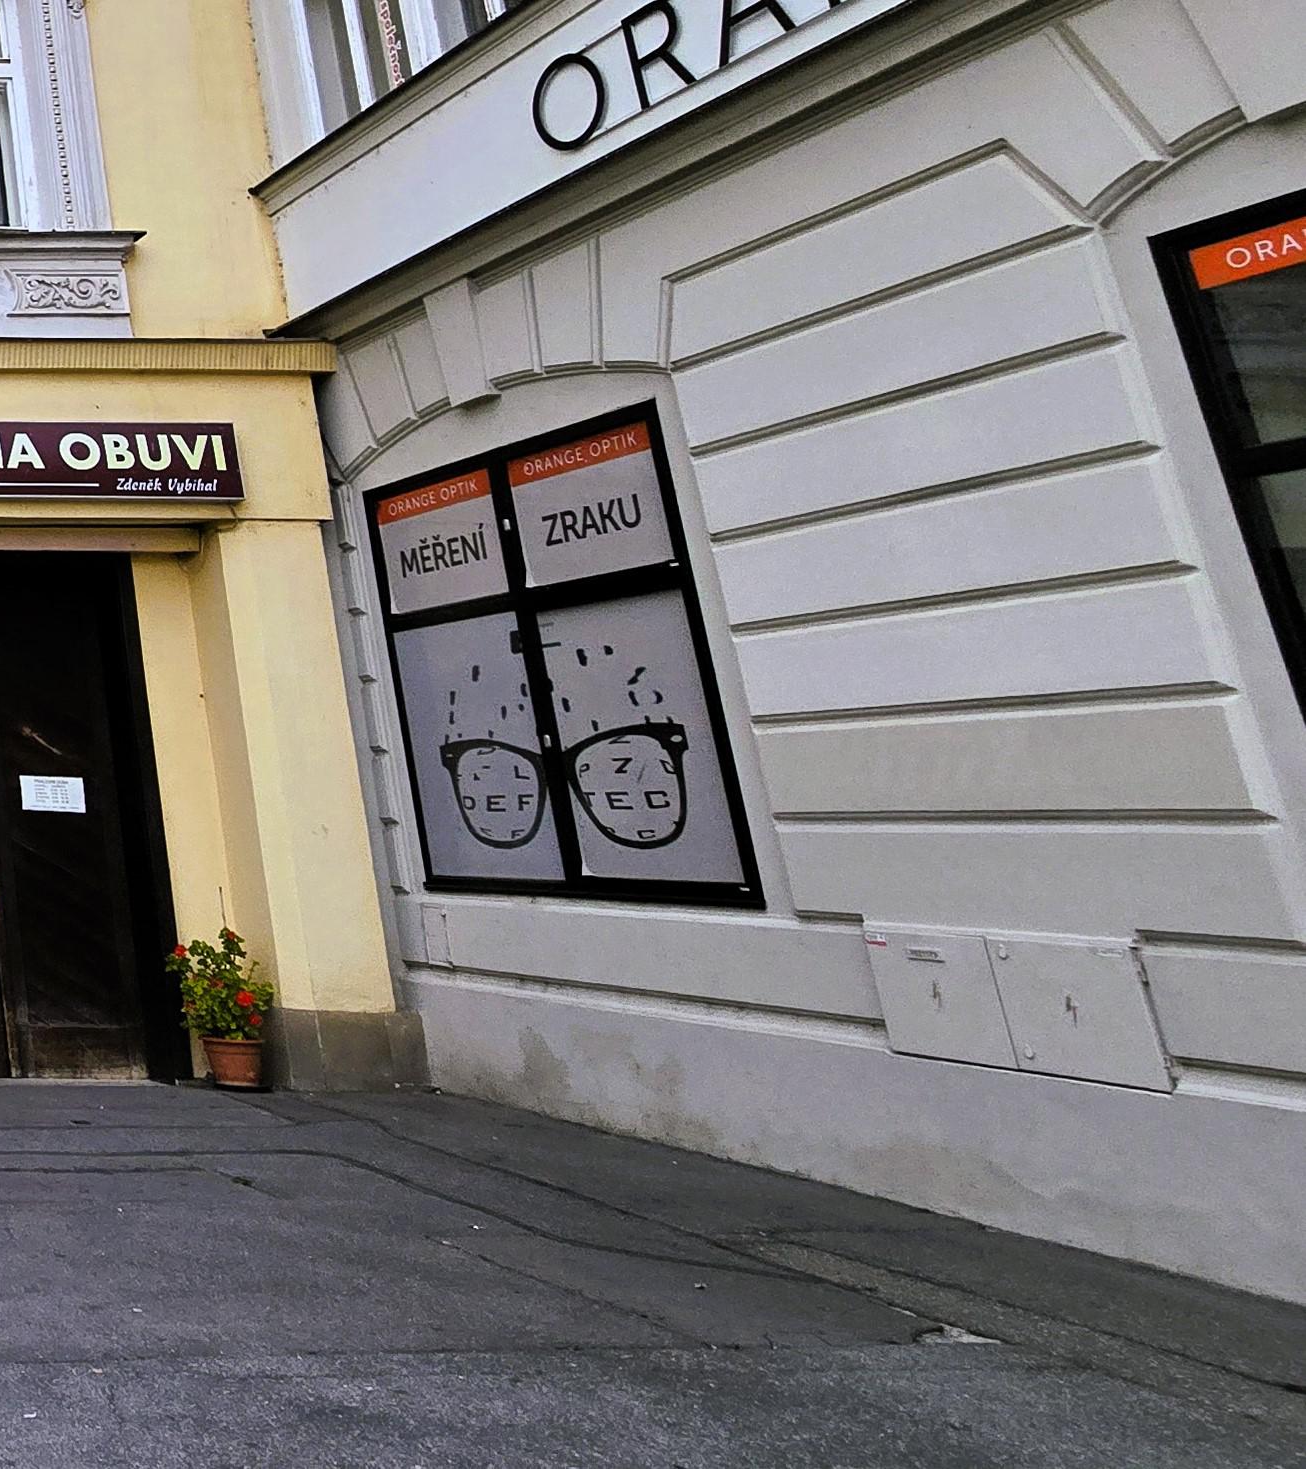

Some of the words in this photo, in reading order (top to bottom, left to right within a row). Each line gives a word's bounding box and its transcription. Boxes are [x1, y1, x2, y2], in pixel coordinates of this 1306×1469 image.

[532, 0, 841, 151] ORA
[1226, 228, 1306, 268] ORA
[59, 432, 227, 472] OBUVI
[523, 450, 584, 477] ORANGE
[589, 432, 637, 457] OPTIK
[116, 477, 162, 491] Zdeněk
[388, 490, 435, 516] ORANGE
[440, 478, 478, 501] OPTIK
[541, 493, 643, 547] ZRAKU
[399, 523, 488, 578] MĚŘENÍ
